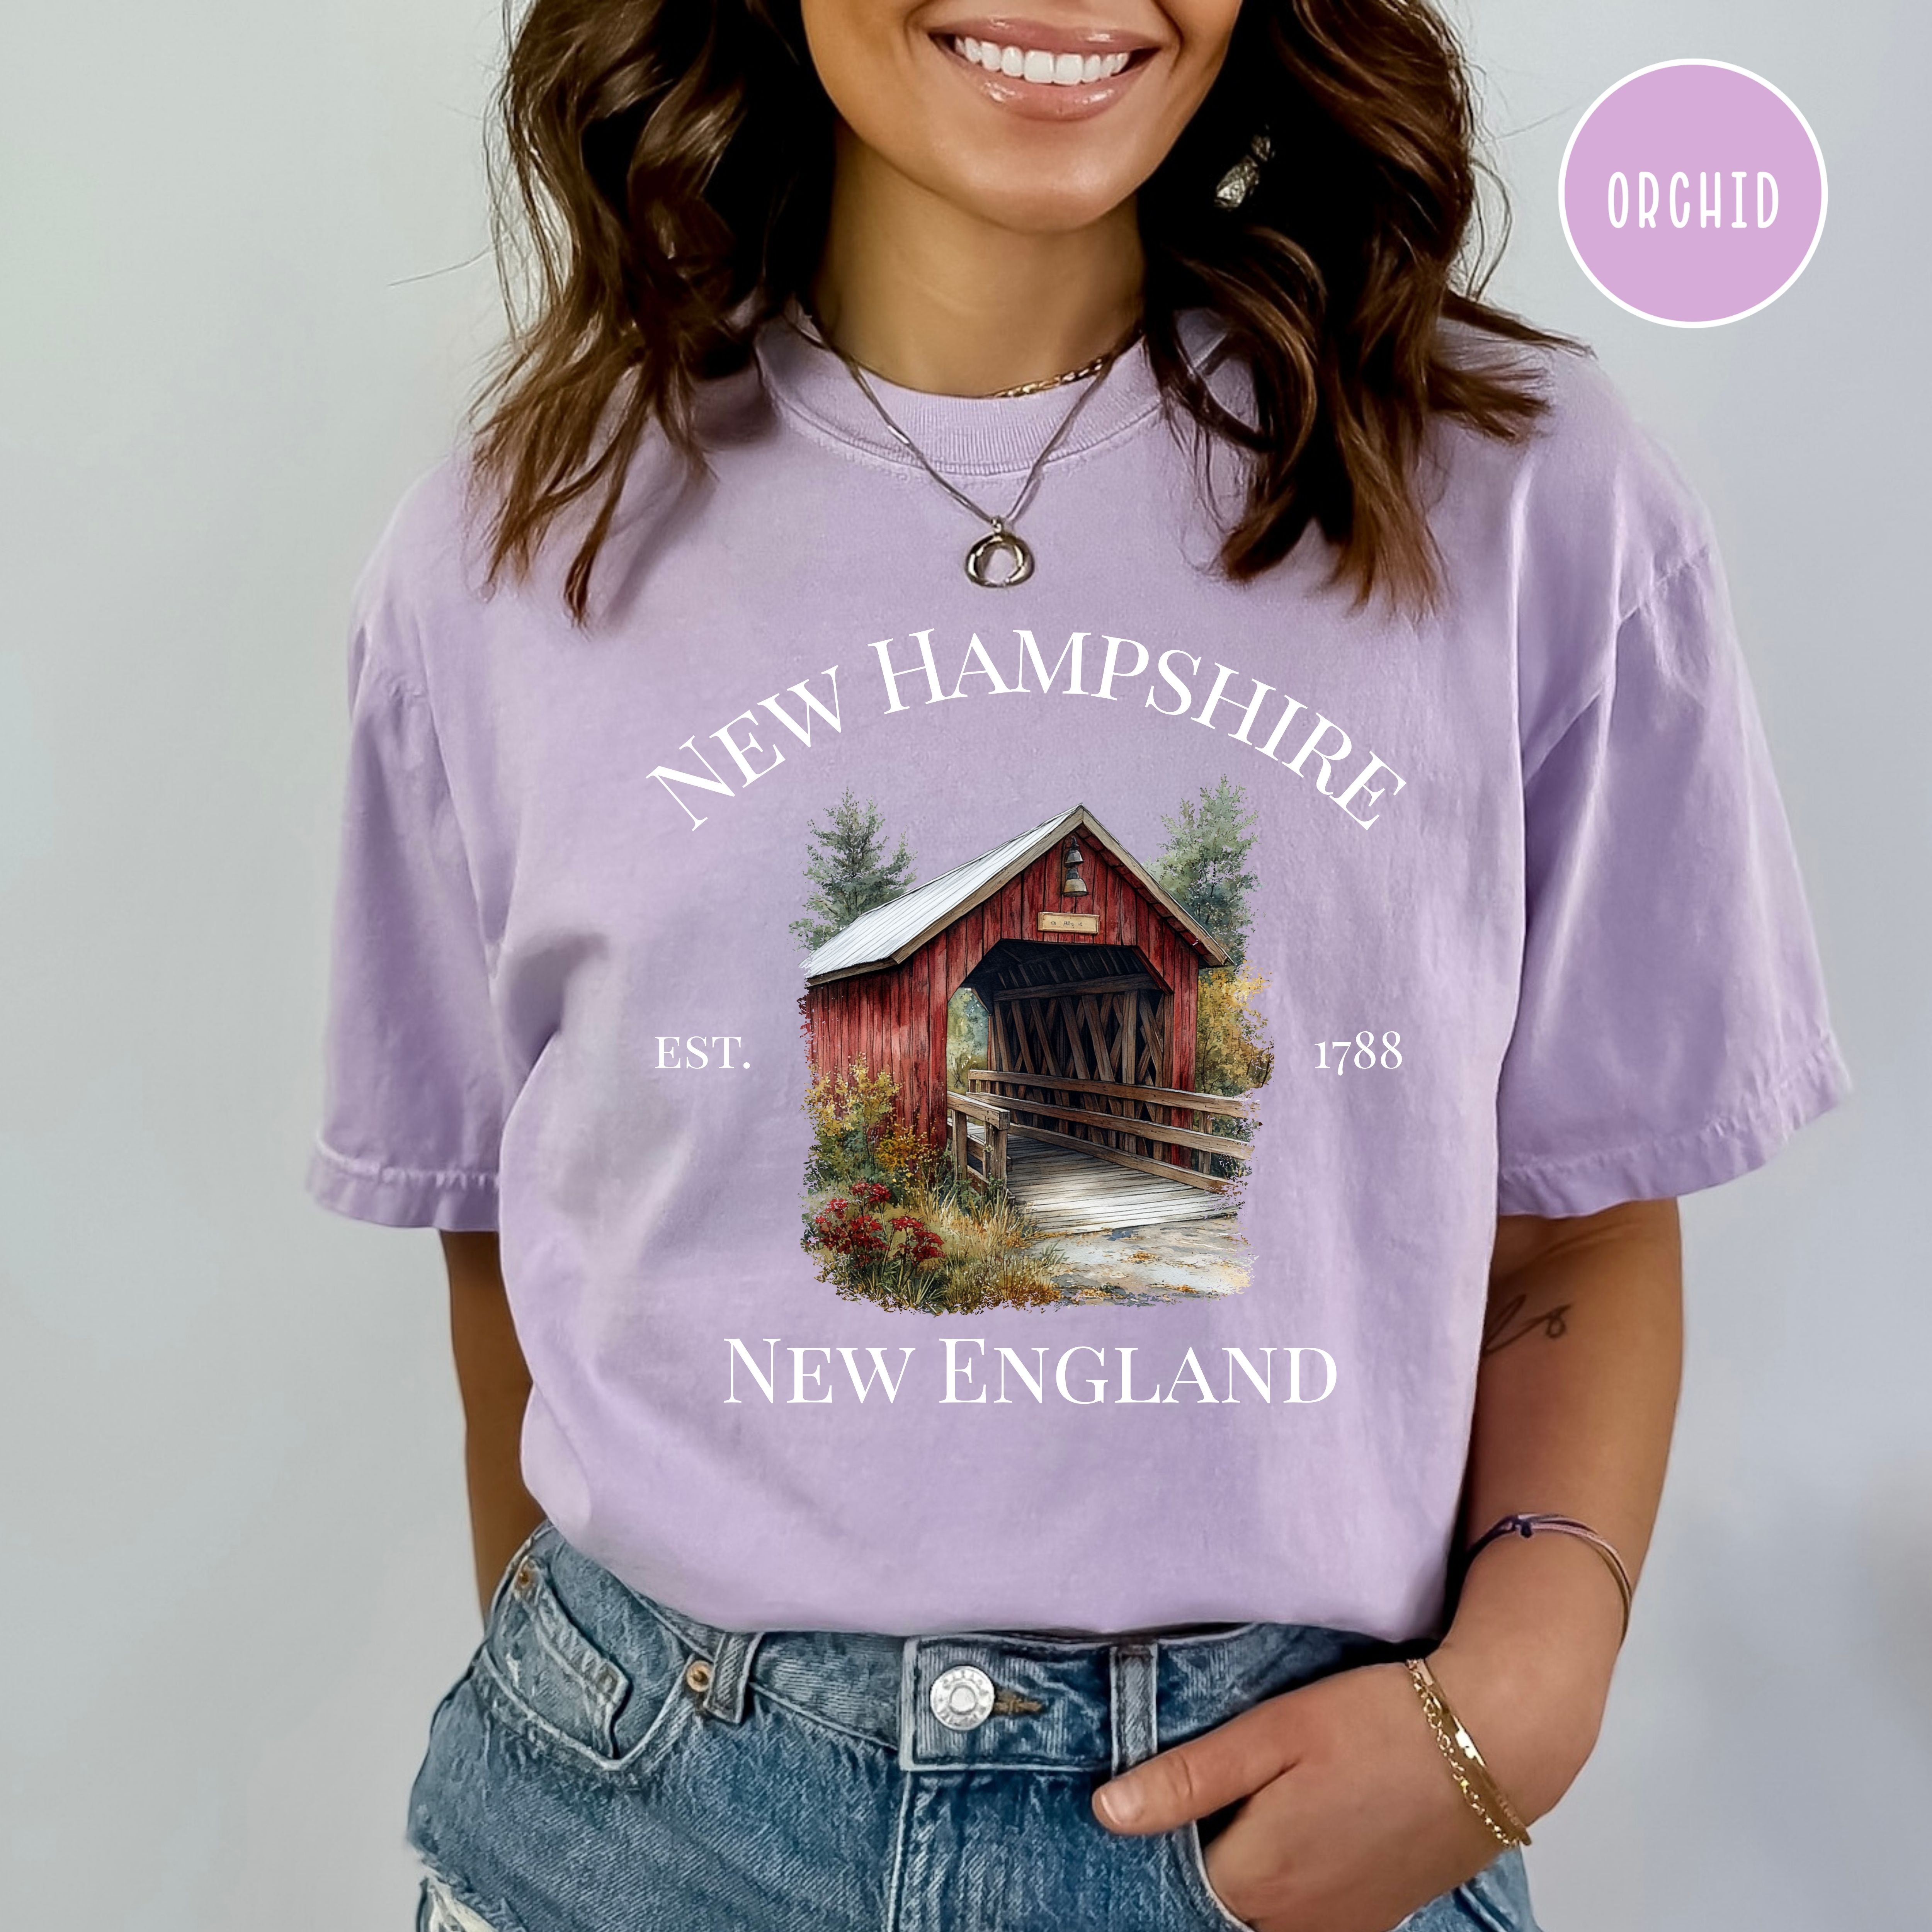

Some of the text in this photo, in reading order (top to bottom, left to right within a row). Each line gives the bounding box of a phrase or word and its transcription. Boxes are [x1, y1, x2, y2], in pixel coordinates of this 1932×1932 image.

[645, 628, 1407, 832] NEW HAMPSHIRE
[655, 1036, 751, 1070] EST.
[1314, 1031, 1403, 1076] 1788
[723, 1338, 1337, 1405] NEW ENGLAND
